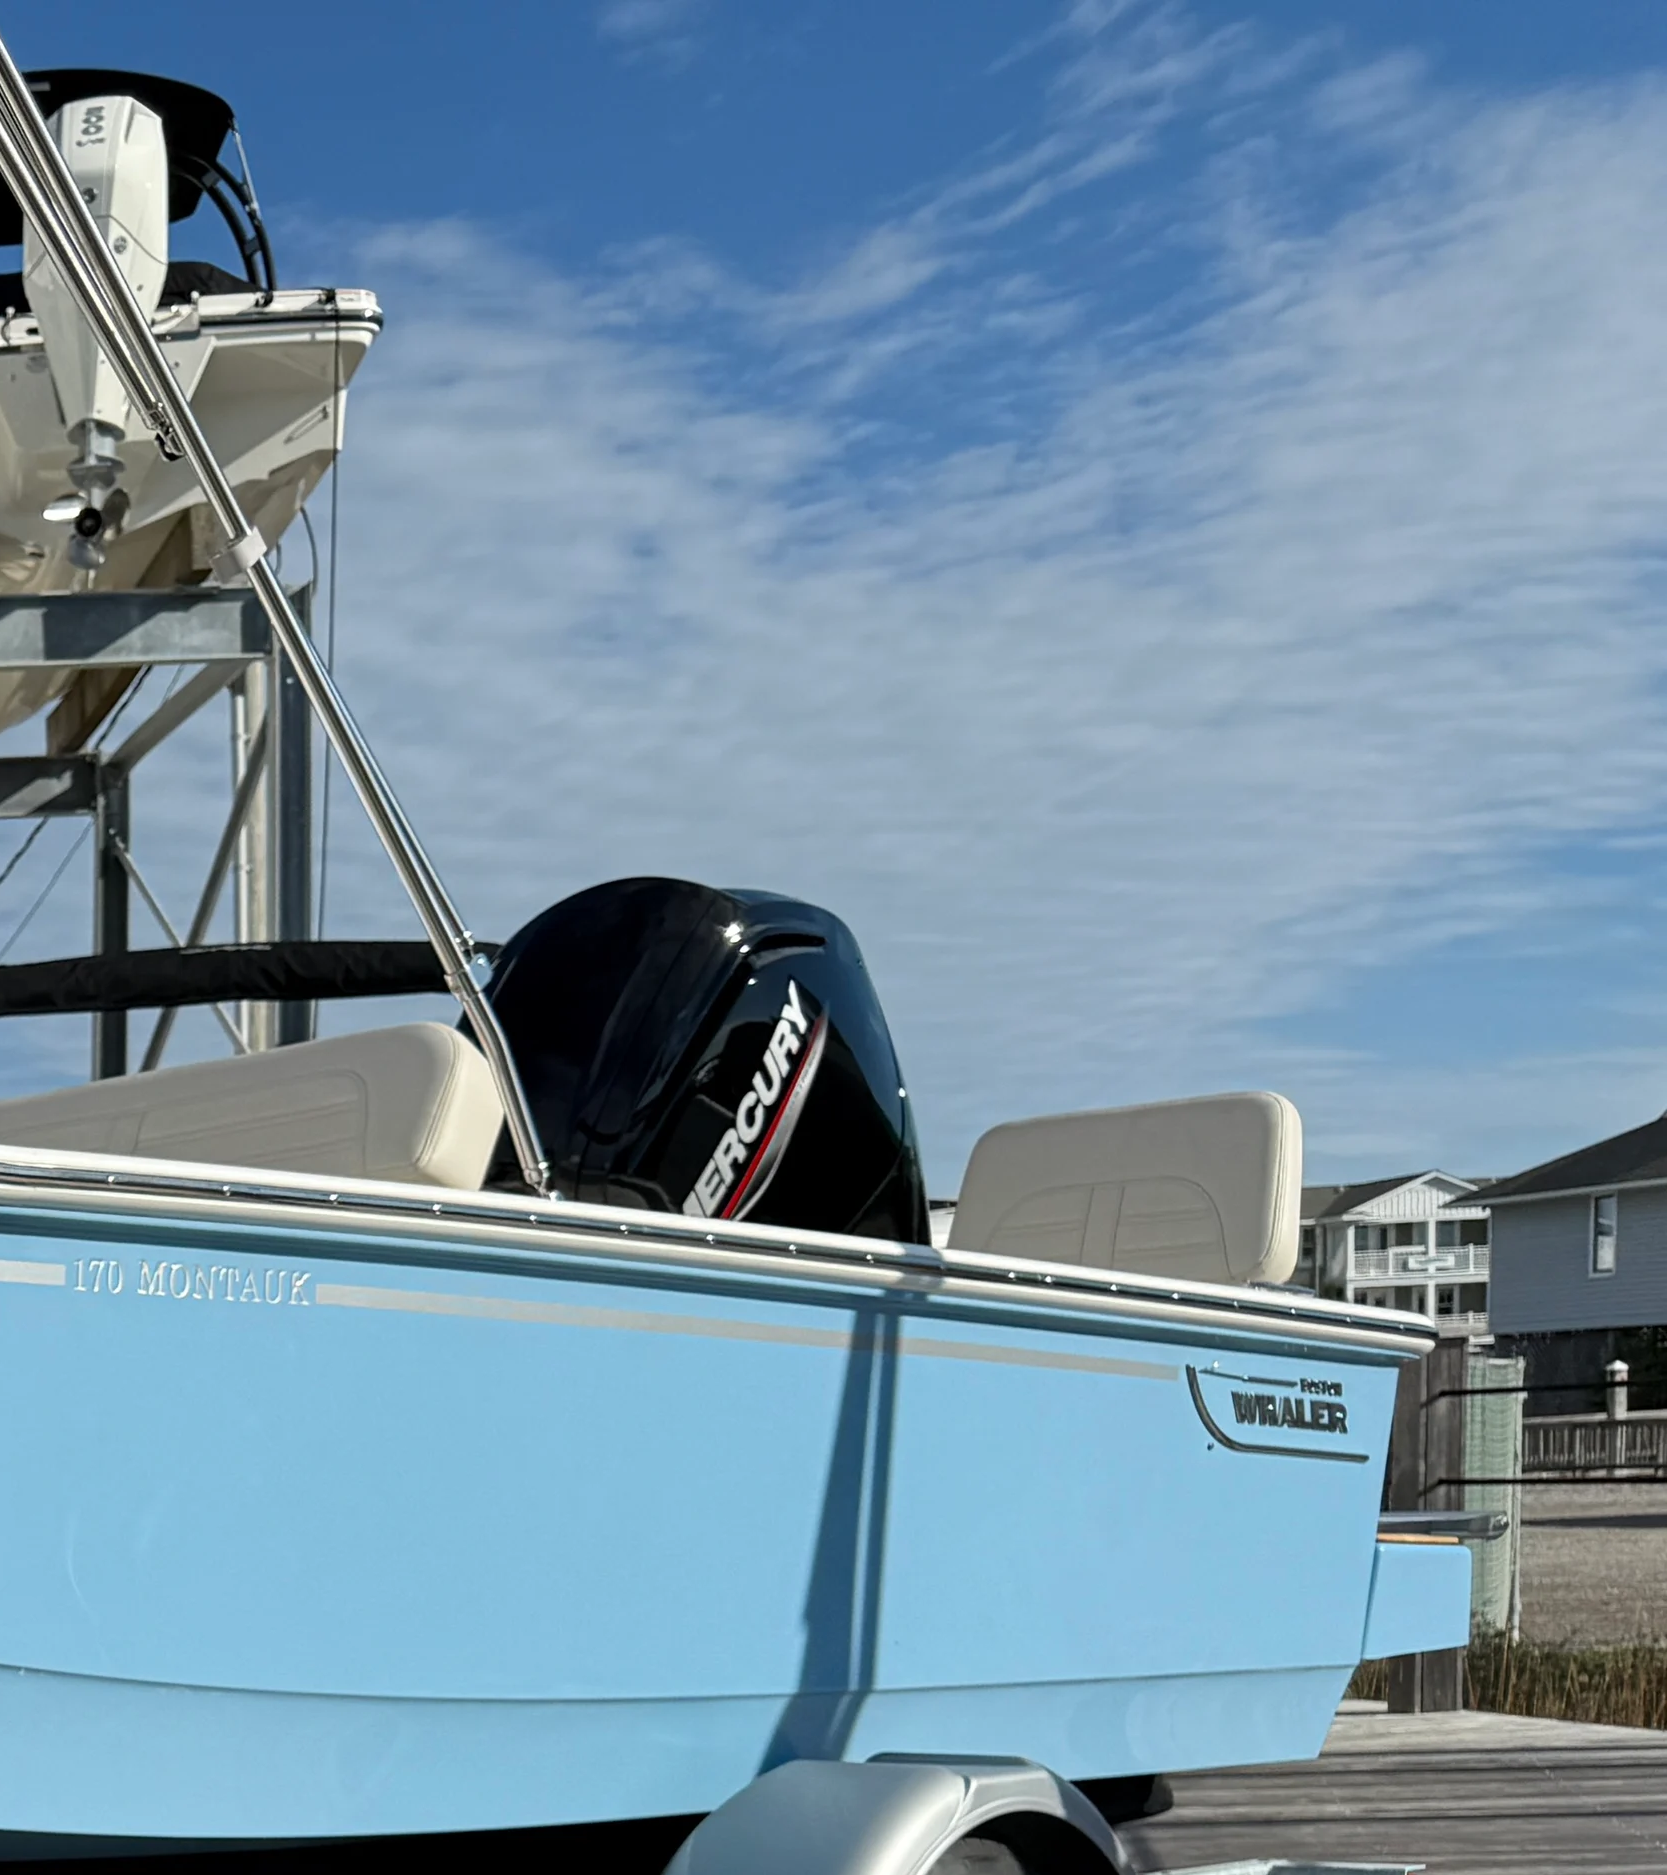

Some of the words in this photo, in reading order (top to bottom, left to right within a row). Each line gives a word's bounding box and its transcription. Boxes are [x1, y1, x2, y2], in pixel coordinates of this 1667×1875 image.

[73, 1259, 124, 1294] 170
[137, 1259, 312, 1306] MONTAUK
[1230, 1391, 1349, 1434] WHALER
